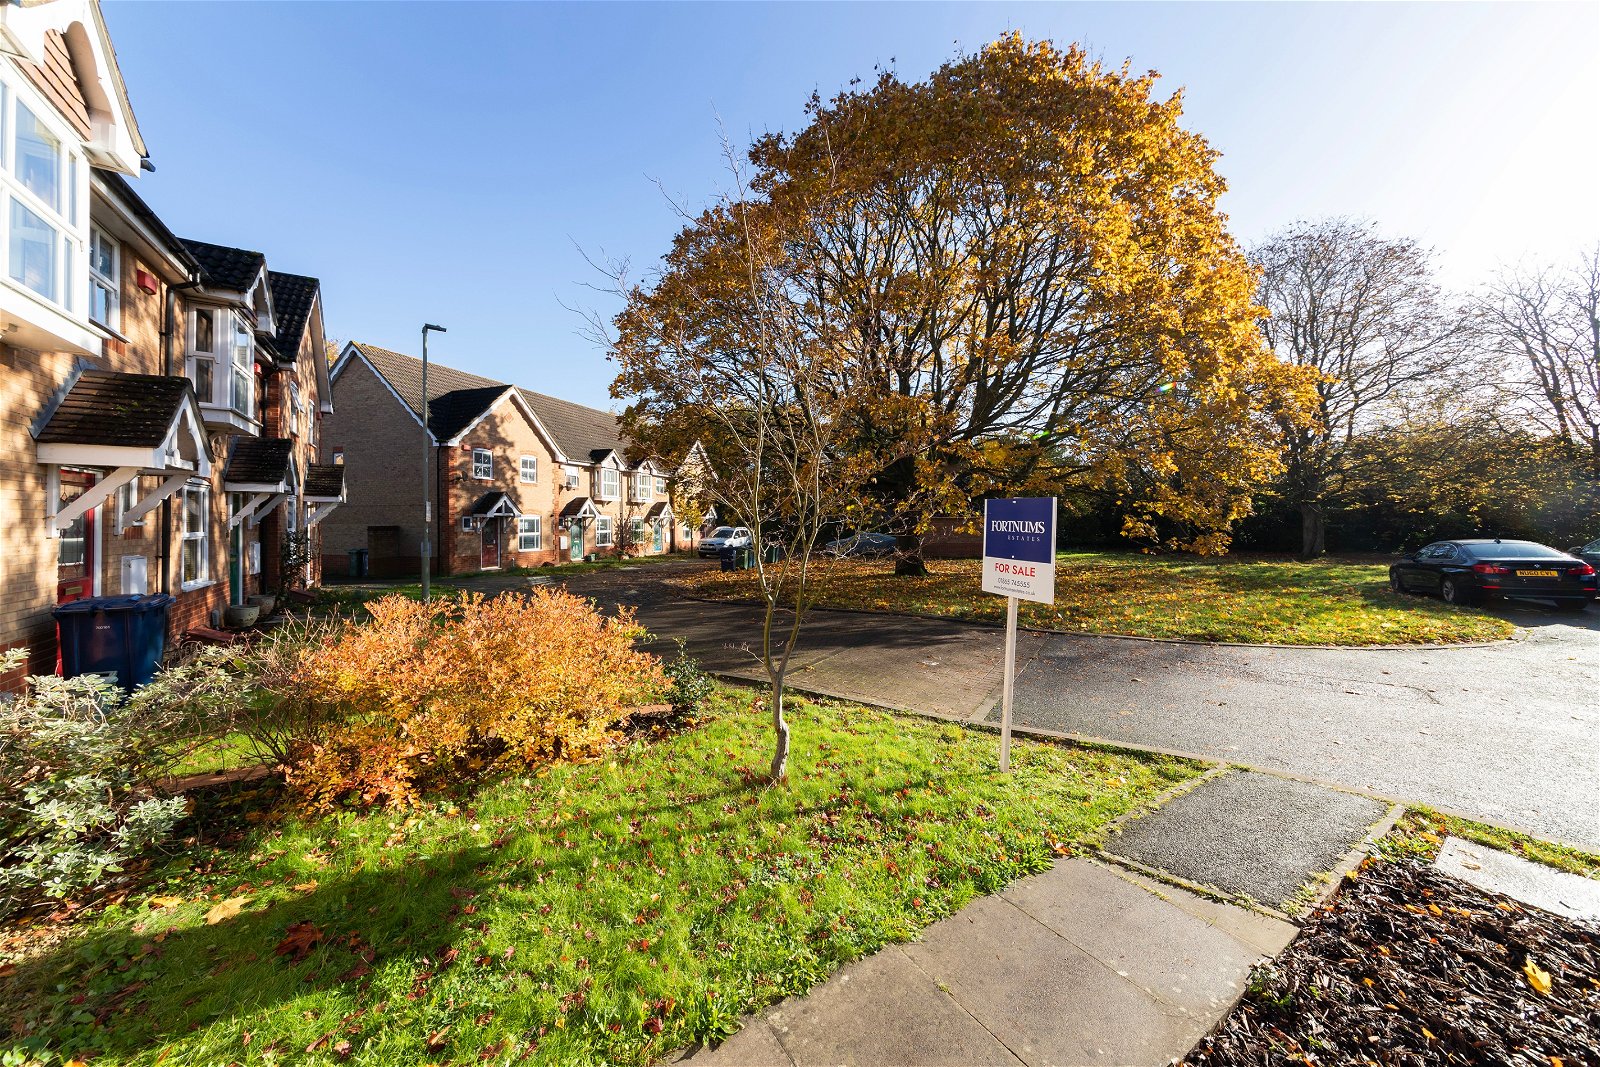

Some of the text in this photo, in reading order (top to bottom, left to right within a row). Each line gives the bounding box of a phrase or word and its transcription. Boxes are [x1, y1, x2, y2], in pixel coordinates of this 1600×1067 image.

[991, 520, 1045, 534] FORTNUMS
[994, 562, 1036, 577] FOR SALE
